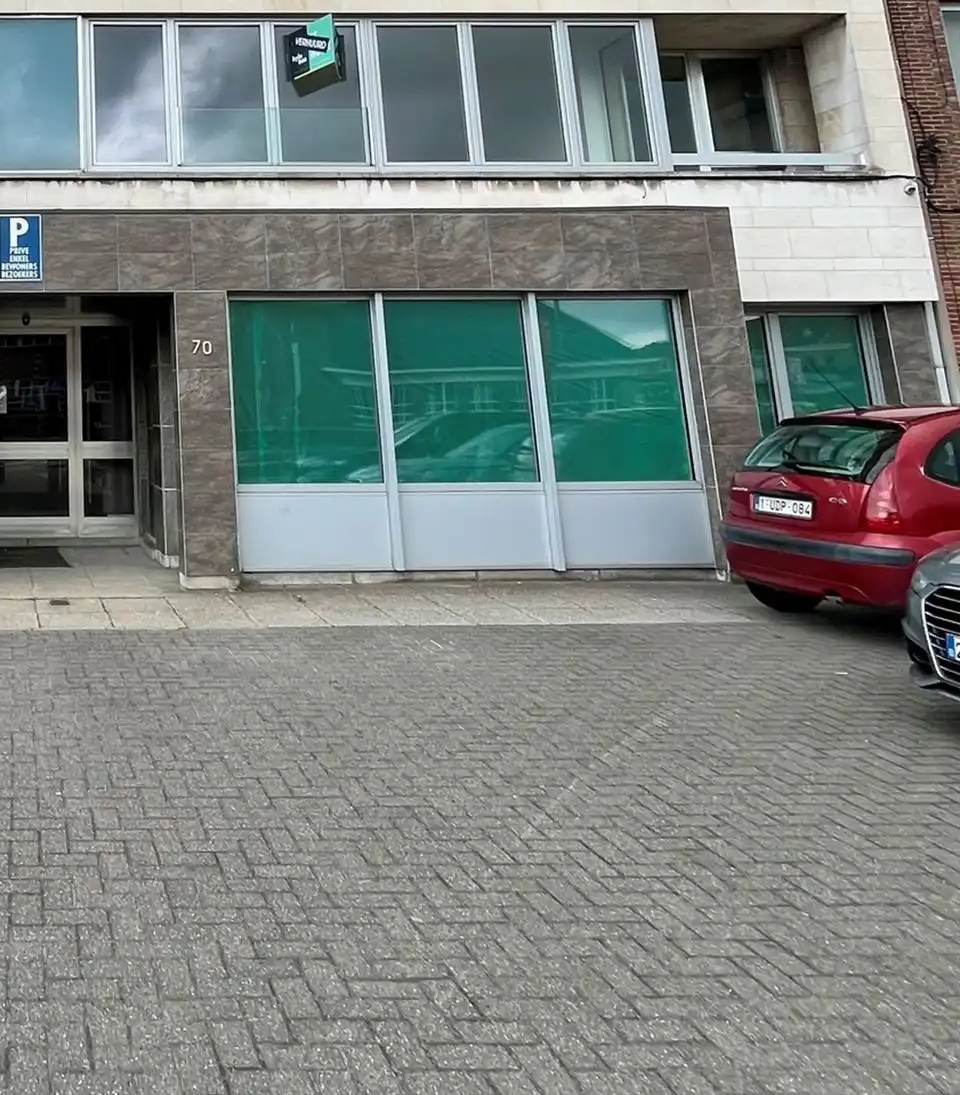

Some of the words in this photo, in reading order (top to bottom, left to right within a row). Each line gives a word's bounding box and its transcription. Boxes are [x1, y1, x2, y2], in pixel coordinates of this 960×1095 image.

[295, 37, 327, 50] VERHUURD
[10, 217, 30, 247] P
[10, 254, 30, 262] ENKEL
[1, 270, 38, 278] BEZOEKERS
[191, 339, 212, 354] 70
